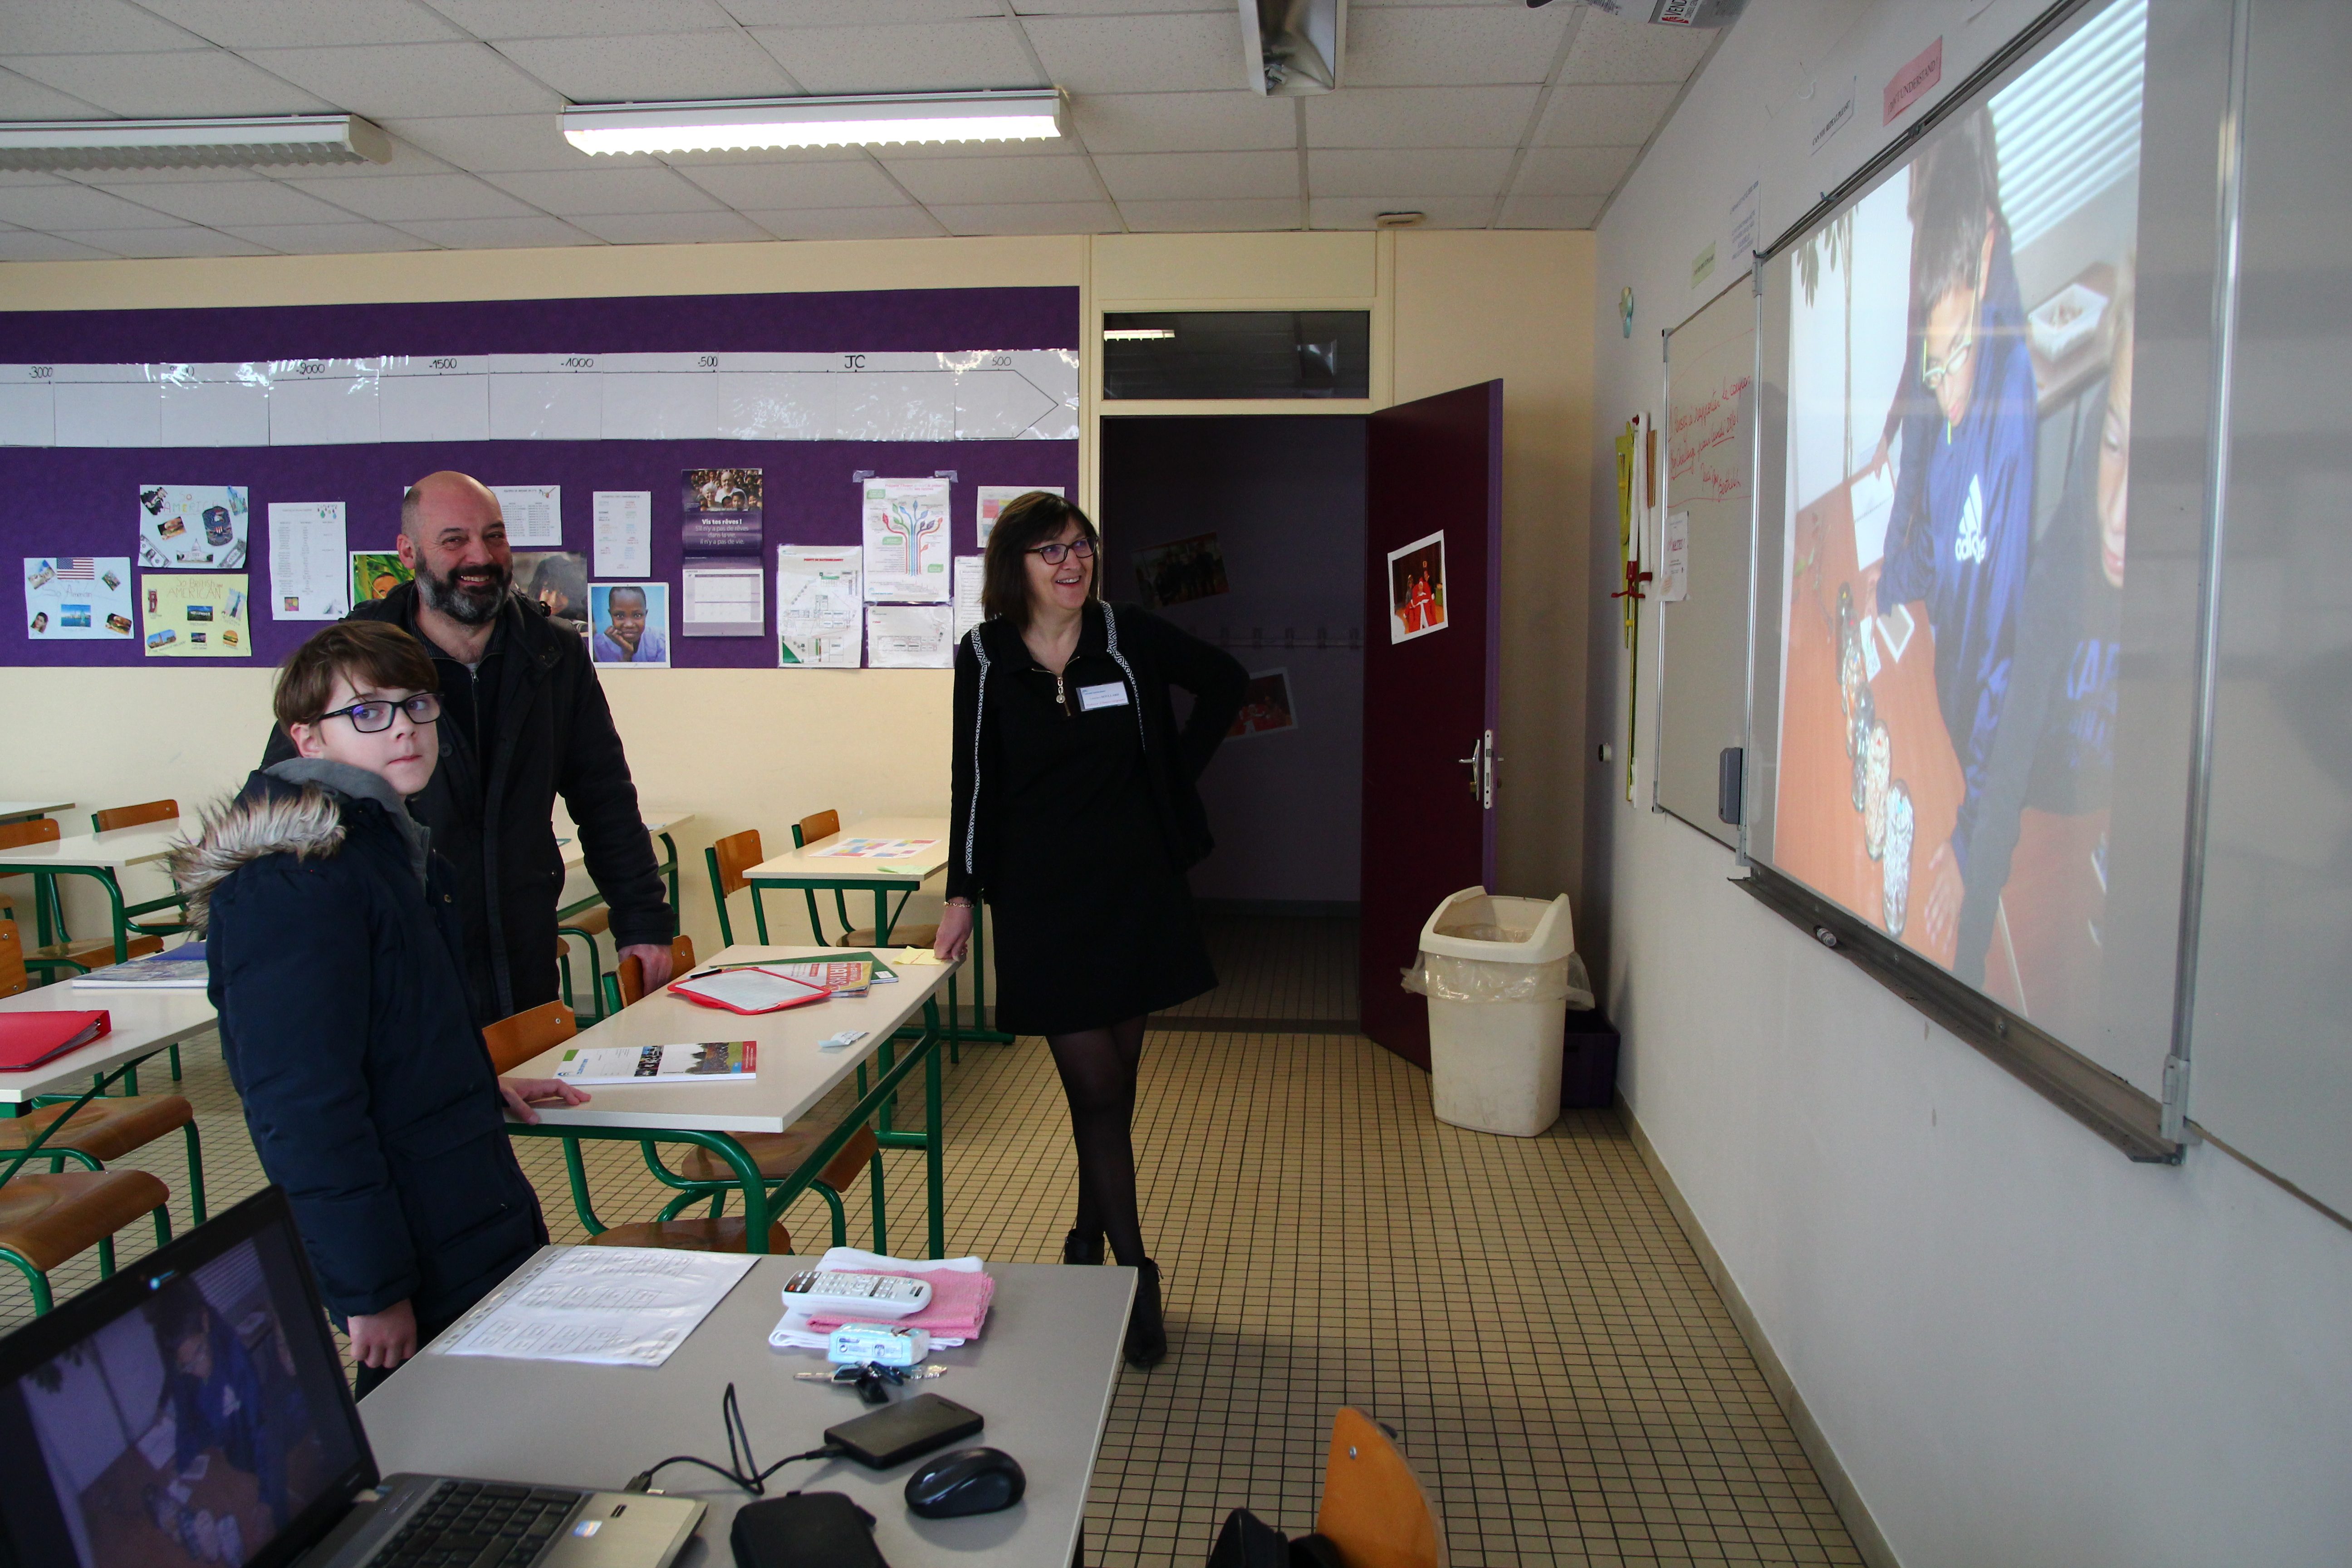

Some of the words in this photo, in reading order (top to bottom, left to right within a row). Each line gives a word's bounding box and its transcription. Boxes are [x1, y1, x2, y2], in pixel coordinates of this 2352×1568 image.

[1900, 60, 1936, 98] UNDERSTAND
[429, 358, 457, 369] -1500
[560, 358, 594, 368] -1000
[698, 355, 718, 367] -500
[844, 354, 866, 368] JC
[992, 356, 1012, 366] 500
[296, 363, 325, 375] -2000
[164, 501, 230, 513] AMERIC
[167, 587, 221, 599] AMERICAN
